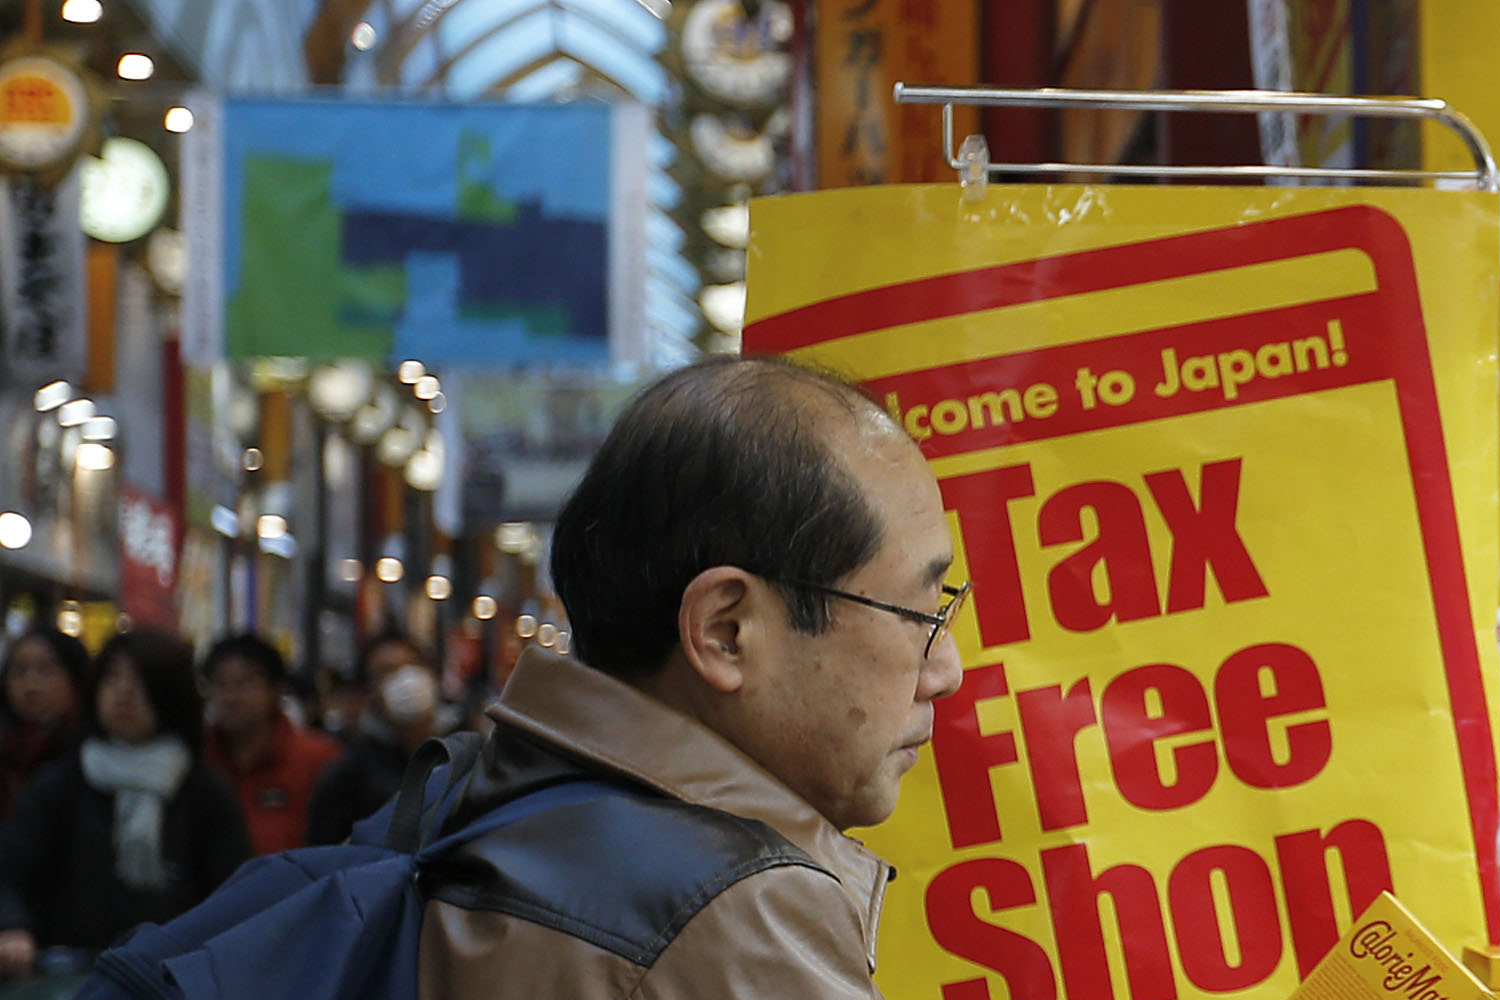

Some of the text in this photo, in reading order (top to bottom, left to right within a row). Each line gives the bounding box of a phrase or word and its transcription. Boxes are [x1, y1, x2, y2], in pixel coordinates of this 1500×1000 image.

[1076, 367, 1136, 410] to
[1154, 320, 1349, 400] Japan!
[938, 457, 1271, 651] Tax
[930, 642, 1334, 850] Free
